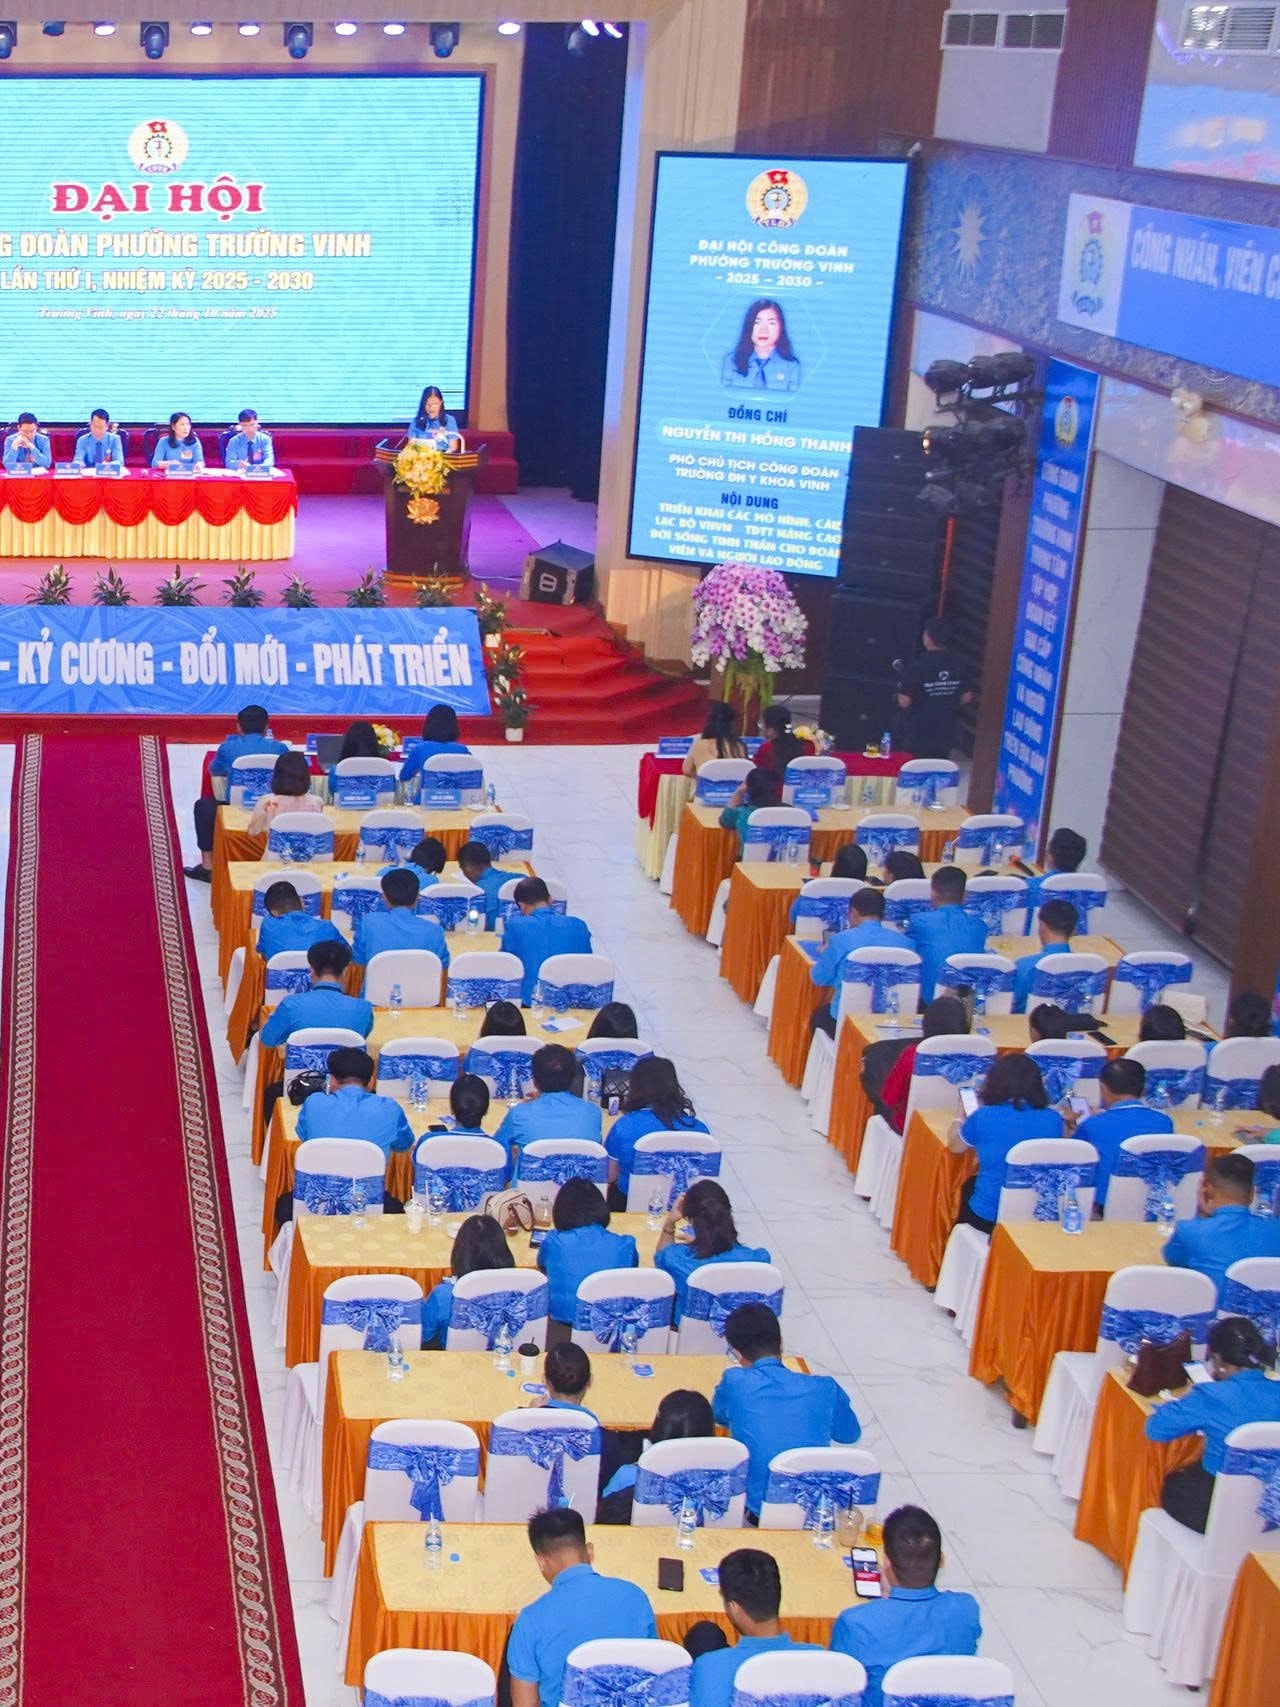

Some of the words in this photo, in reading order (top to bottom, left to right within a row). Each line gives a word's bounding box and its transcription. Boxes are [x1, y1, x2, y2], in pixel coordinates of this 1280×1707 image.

[52, 183, 150, 221] ĐẠI
[167, 176, 264, 221] HỘI
[20, 229, 89, 258] ĐOÀN
[96, 227, 199, 258] PHƯỜNG
[205, 227, 305, 258] TRƯỜNG
[312, 232, 371, 258] VINH
[698, 239, 723, 254] ĐẠI
[727, 239, 752, 255] HỘI
[757, 239, 800, 255] CÔNG
[805, 243, 849, 257] ĐOÀN
[819, 261, 855, 273] VINH
[0, 265, 39, 291] LẦN
[44, 267, 80, 291] THỨ
[85, 271, 97, 293] I,
[103, 267, 165, 294] NHIỆM
[171, 266, 195, 290] KỲ
[201, 270, 248, 290] 2025
[267, 270, 313, 290] 2030
[726, 272, 760, 285] 2025
[776, 275, 812, 287] 2030
[766, 408, 788, 423] CHÍ
[662, 424, 720, 442] NGUYỄN
[725, 431, 746, 446] THỊ
[800, 437, 852, 454] THANH
[727, 458, 755, 472] TỊCH
[759, 460, 798, 475] CÔNG
[749, 474, 757, 484] Y
[759, 475, 796, 489] KHOA
[799, 479, 831, 492] VINH
[721, 491, 741, 507] NỘI
[746, 495, 779, 509] DUNG
[18, 627, 54, 684] KỶ
[61, 637, 154, 685] CƯƠNG
[180, 626, 227, 686] ĐỔI
[234, 634, 287, 686] MỚI
[313, 634, 385, 686] PHÁT
[389, 626, 473, 686] TRIỂN
